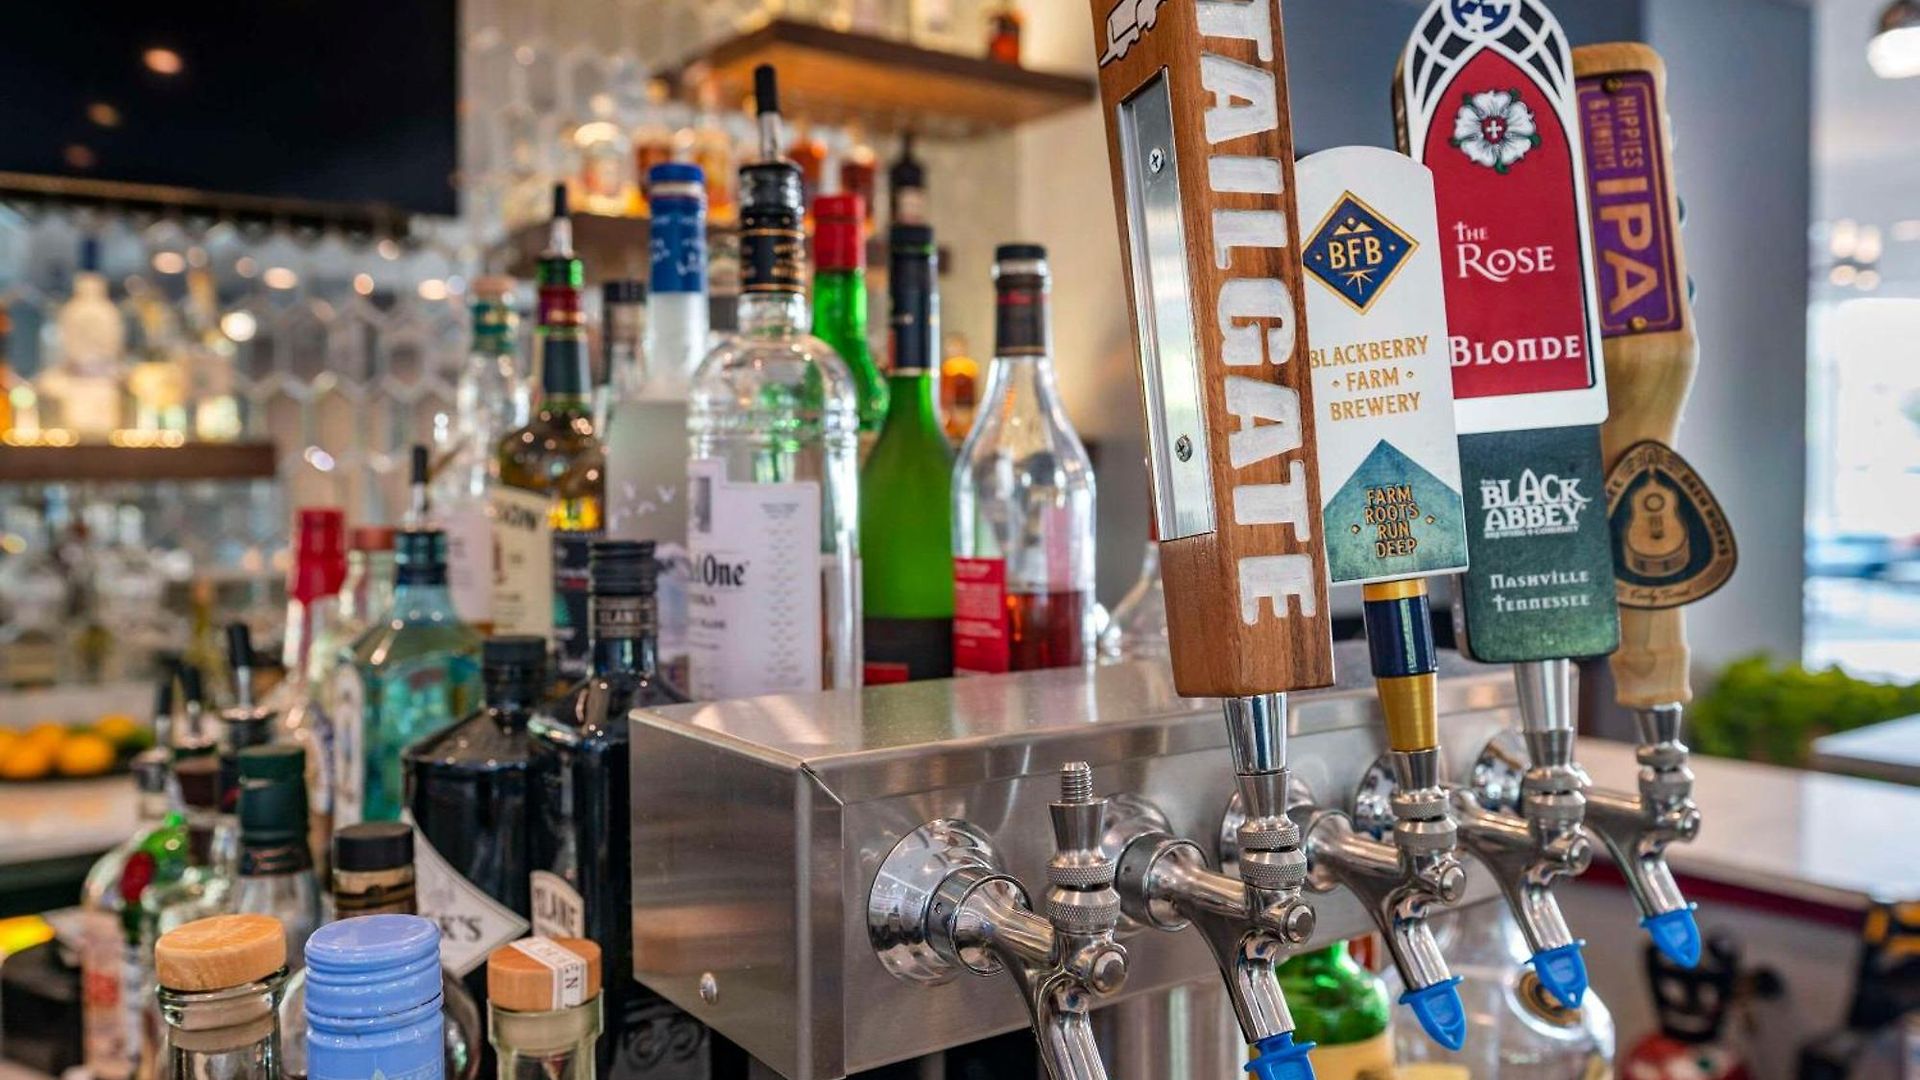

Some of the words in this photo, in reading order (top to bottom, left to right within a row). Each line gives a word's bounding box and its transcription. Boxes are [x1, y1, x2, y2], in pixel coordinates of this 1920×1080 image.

[1617, 96, 1643, 169] HIPPIES
[1453, 221, 1489, 242] THE
[1596, 176, 1658, 316] IPA
[1328, 236, 1384, 270] BFB
[1457, 243, 1556, 282] ROSE
[1195, 0, 1316, 626] TAILGATE
[1310, 335, 1428, 369] BLACKBERRY
[1449, 334, 1582, 368] BLONDE
[1346, 367, 1399, 392] FARM
[1330, 392, 1421, 421] BREWERY
[1366, 483, 1413, 506] FARM
[1480, 468, 1593, 510] BLACK
[1364, 502, 1419, 525] ROOTS
[1484, 501, 1580, 533] ABBEY
[1377, 520, 1411, 541] RUN
[1375, 538, 1418, 558] DEEP
[1490, 570, 1590, 590] NASHVILLE
[1493, 594, 1591, 612] TENNESSEE
